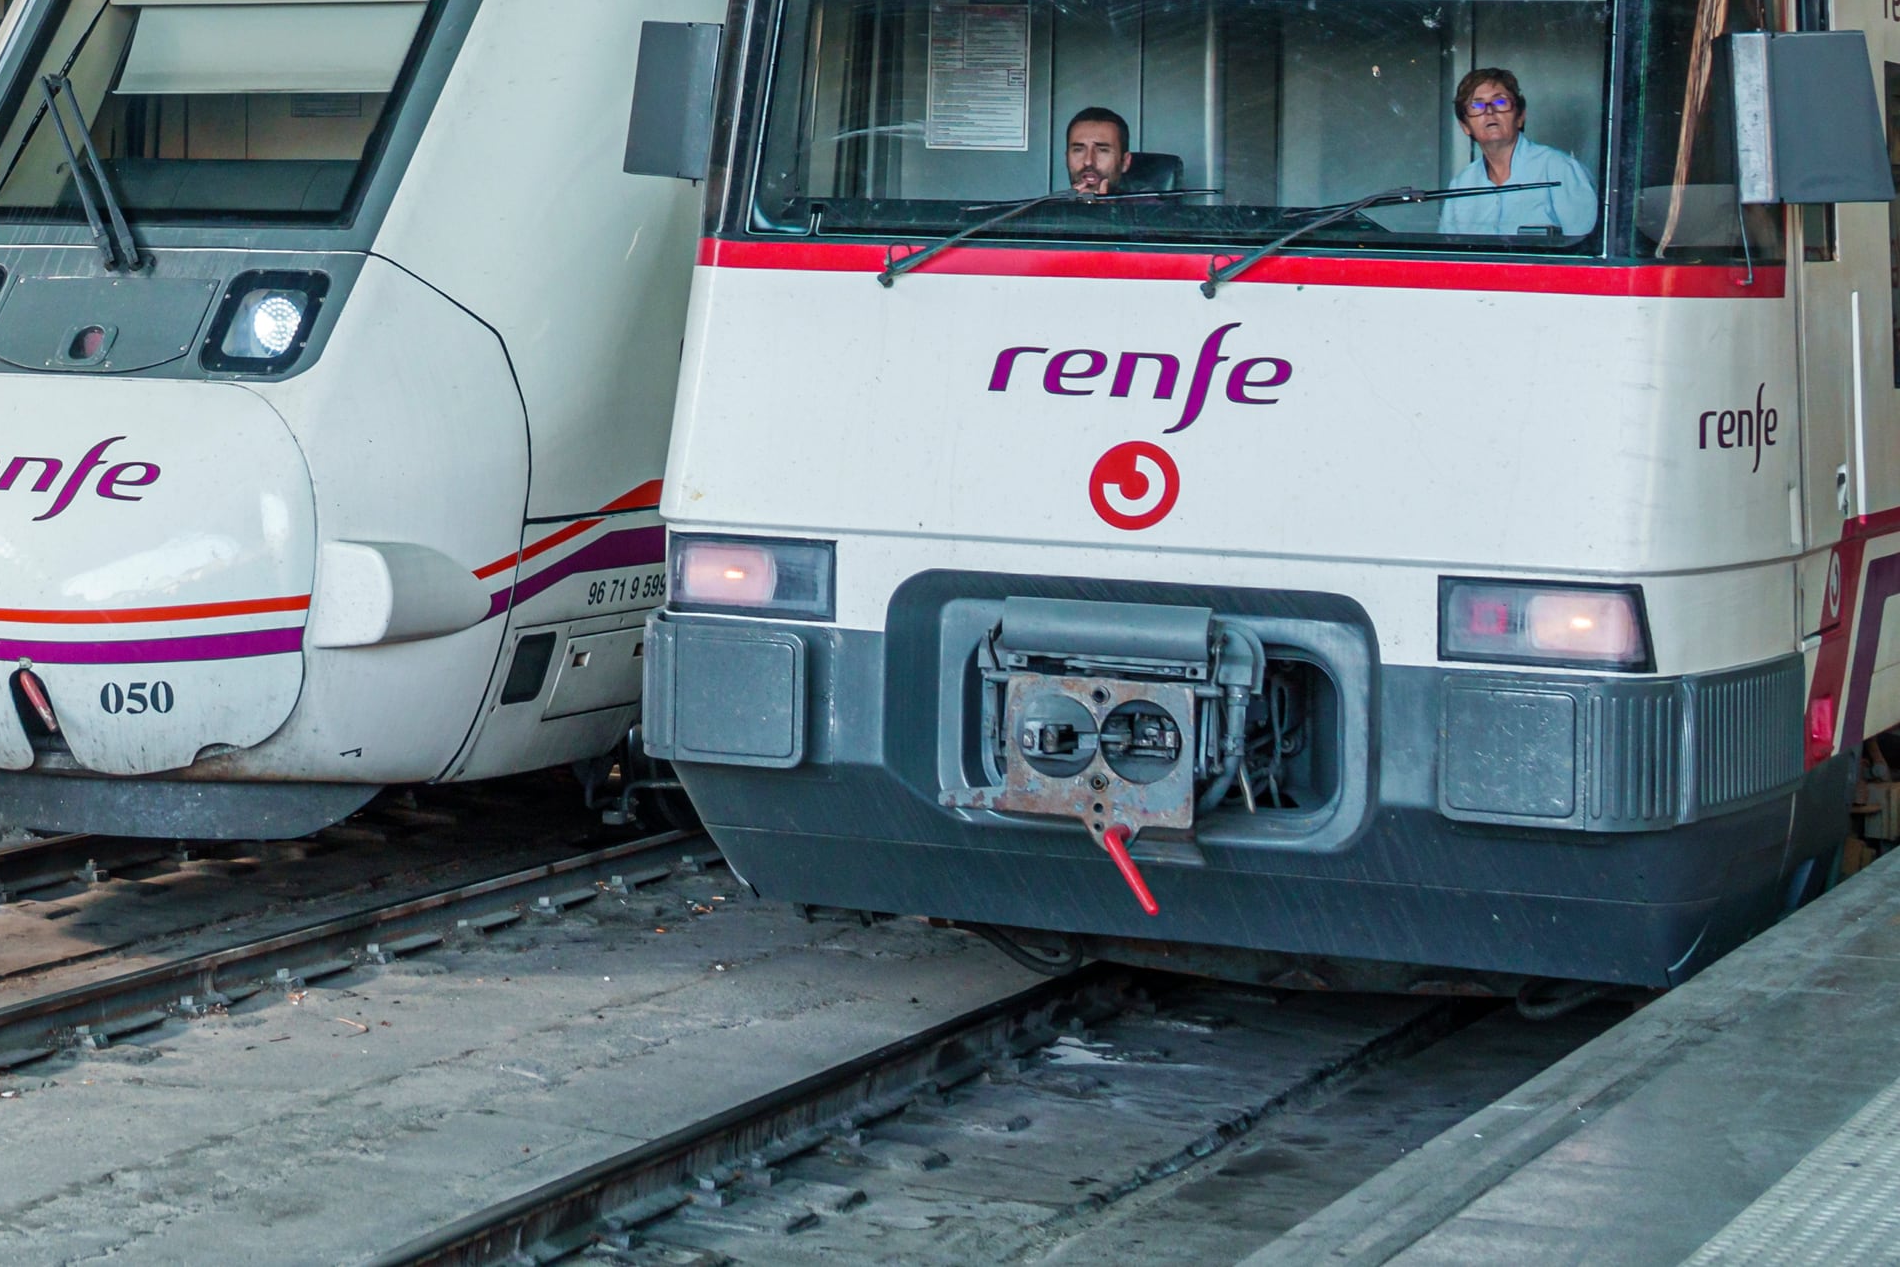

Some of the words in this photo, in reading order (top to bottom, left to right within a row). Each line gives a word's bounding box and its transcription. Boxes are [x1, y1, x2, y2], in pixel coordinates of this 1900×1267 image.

[987, 322, 1293, 434] renfe
[1698, 382, 1779, 474] renfe
[587, 580, 607, 606] 96
[609, 577, 627, 603] 71
[629, 576, 641, 600] 9
[100, 680, 175, 715] 050
